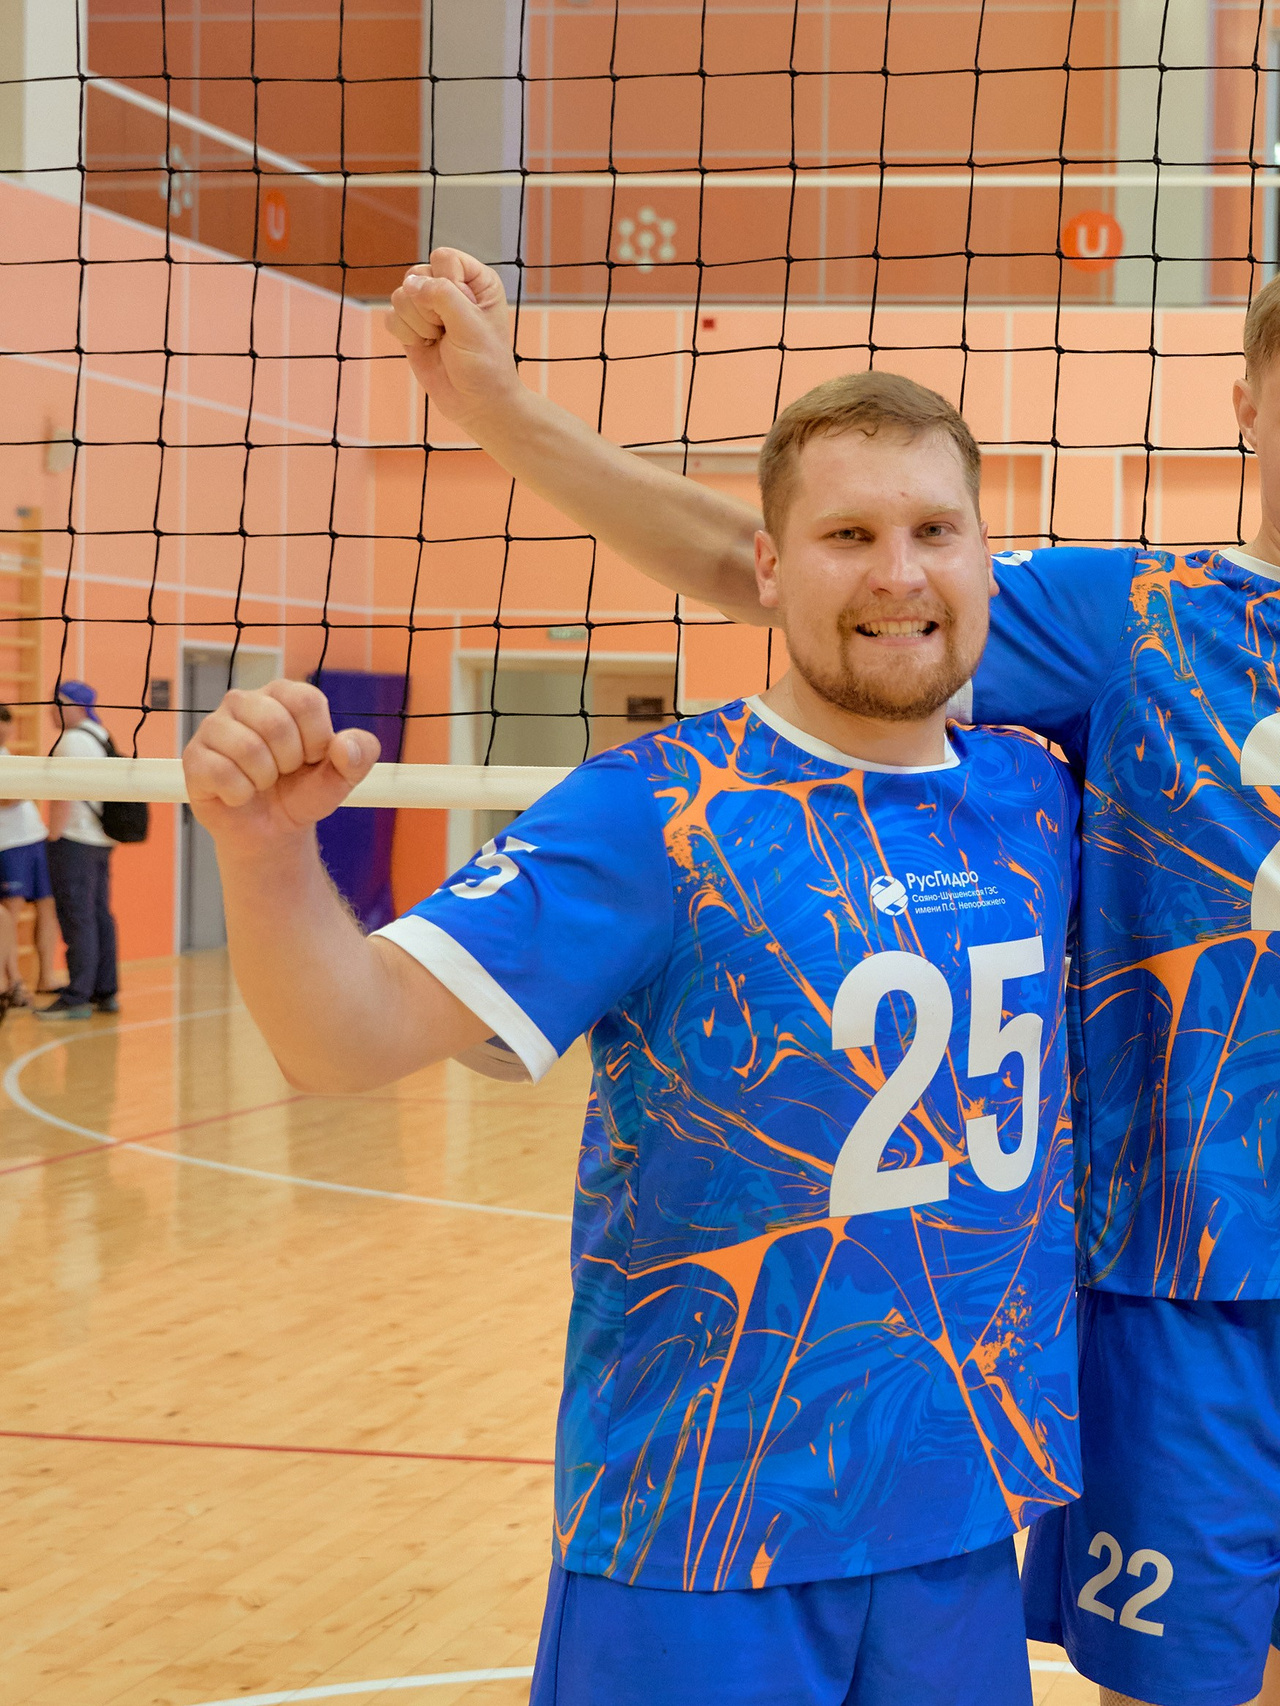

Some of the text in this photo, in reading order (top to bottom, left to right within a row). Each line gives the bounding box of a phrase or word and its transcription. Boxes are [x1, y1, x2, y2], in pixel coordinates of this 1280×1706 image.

[1077, 225, 1108, 258] U
[905, 870, 979, 892] РусГидро
[911, 885, 999, 903] Саяно-Шушенская ГЭС
[914, 897, 1006, 914] имени П.С. Непорожнего
[829, 935, 1045, 1218] 25
[1077, 1530, 1174, 1637] 22
